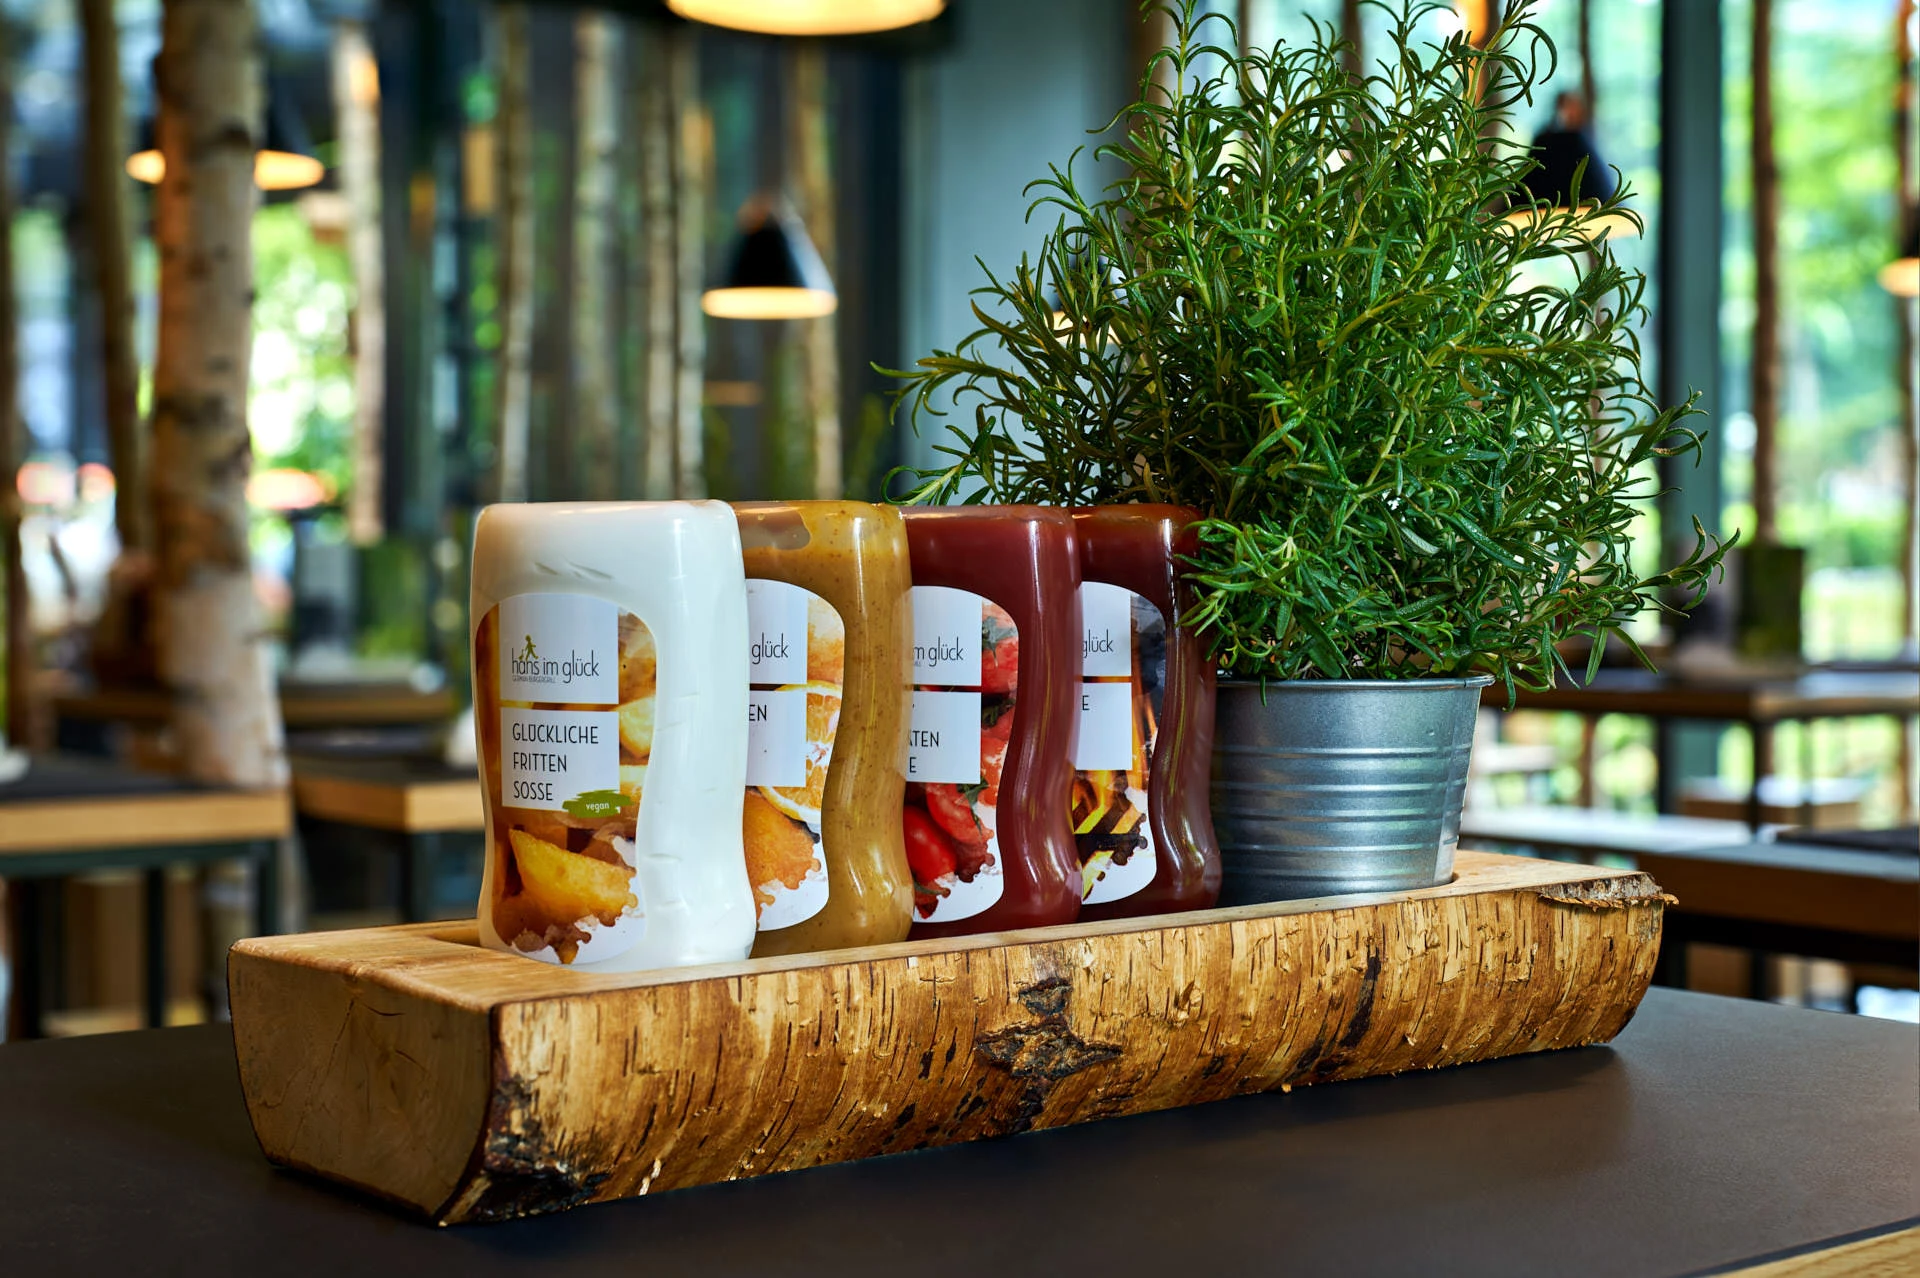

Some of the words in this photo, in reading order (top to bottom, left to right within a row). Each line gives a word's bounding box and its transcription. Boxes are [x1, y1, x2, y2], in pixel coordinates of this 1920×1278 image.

[751, 632, 789, 665] glück
[913, 646, 925, 660] m
[928, 636, 964, 667] glück
[511, 648, 540, 676] hans
[543, 657, 559, 677] im
[562, 650, 600, 684] glück
[748, 704, 767, 721] EN
[512, 723, 600, 745] GLÜCKLICHE
[513, 752, 568, 773] FRITTEN
[513, 780, 554, 801] SOSSE
[585, 801, 611, 813] vegan
